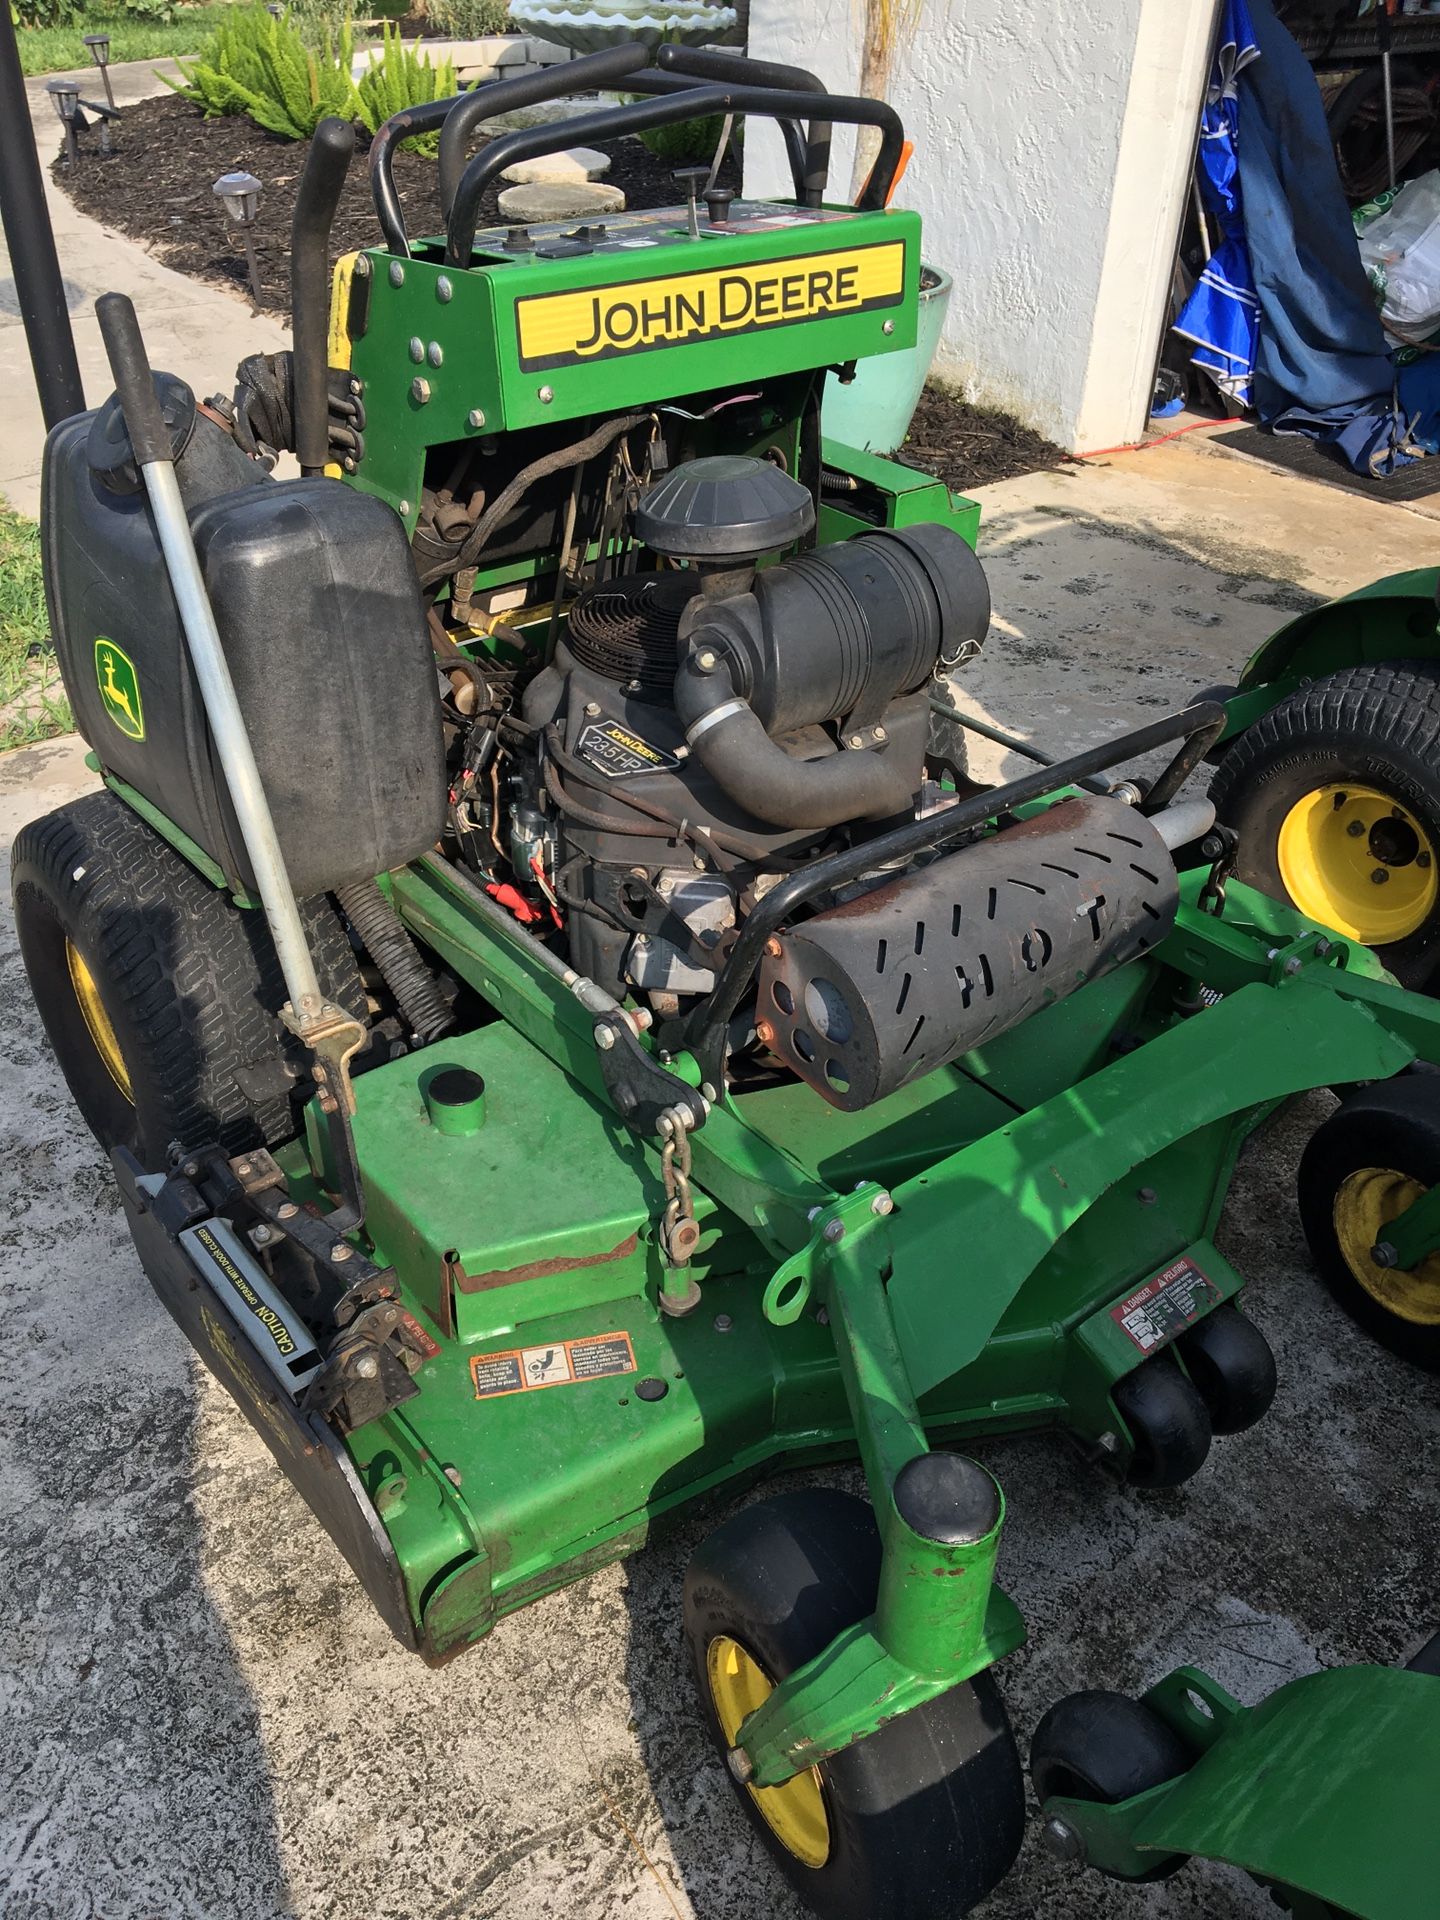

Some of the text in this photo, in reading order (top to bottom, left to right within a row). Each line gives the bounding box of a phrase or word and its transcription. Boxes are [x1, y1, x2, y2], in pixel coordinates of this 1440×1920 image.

[576, 265, 859, 349] JOHN DEERE
[584, 736, 620, 758] 23.5
[613, 753, 642, 769] HP
[606, 728, 634, 746] JOHN
[630, 740, 663, 763] DEERE
[953, 894, 1106, 1010] HOT
[1163, 1260, 1188, 1282] PELIGRO
[198, 1227, 294, 1353] CAUTION OPERATE WITH DOOR CLOSED
[1127, 1287, 1153, 1308] DANGER
